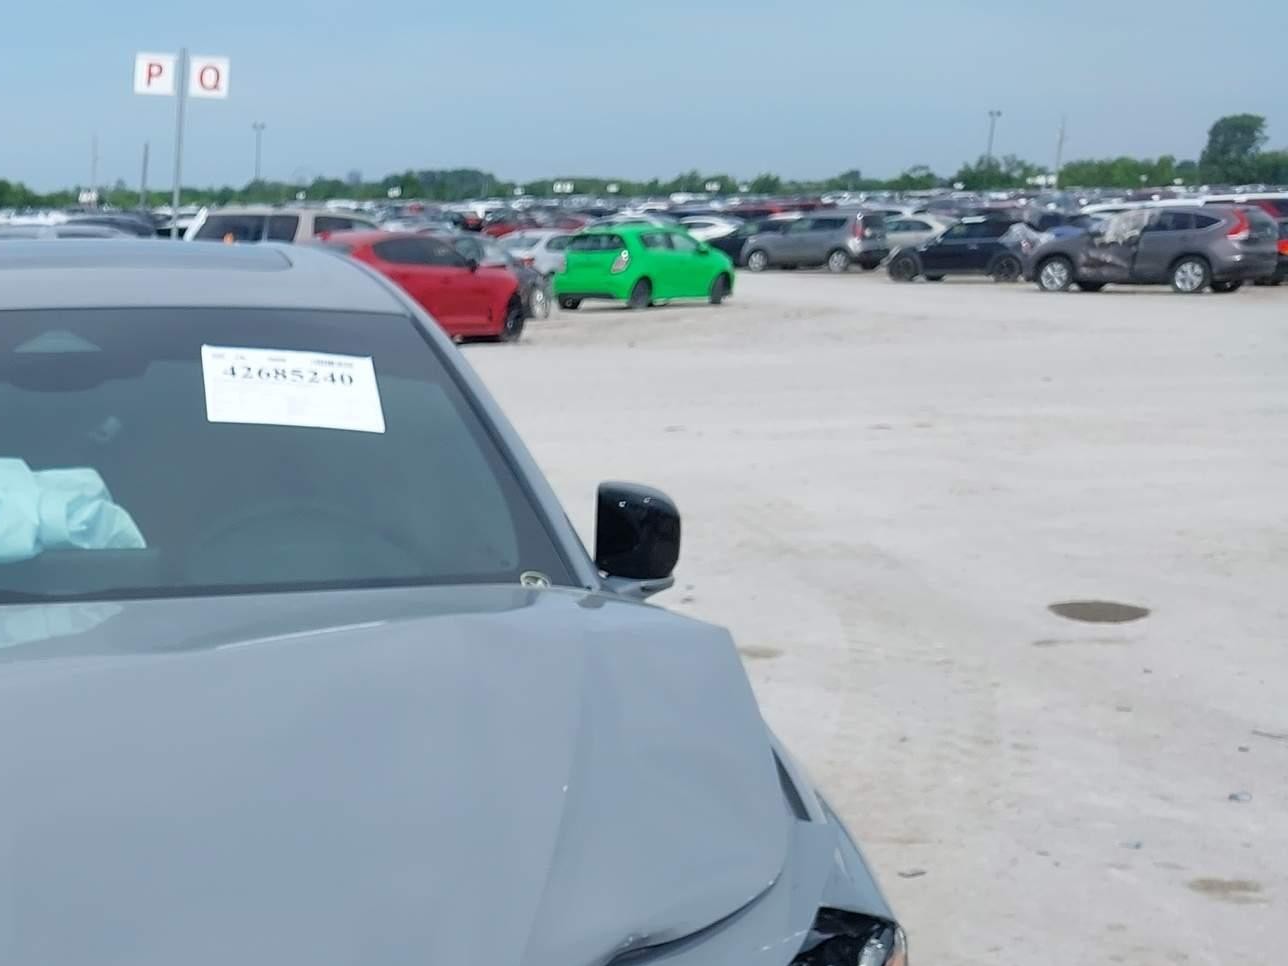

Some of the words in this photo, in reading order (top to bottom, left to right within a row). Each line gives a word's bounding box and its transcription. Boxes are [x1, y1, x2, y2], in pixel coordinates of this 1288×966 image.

[147, 63, 163, 86] P
[200, 65, 220, 91] Q
[223, 364, 354, 386] 42685240
